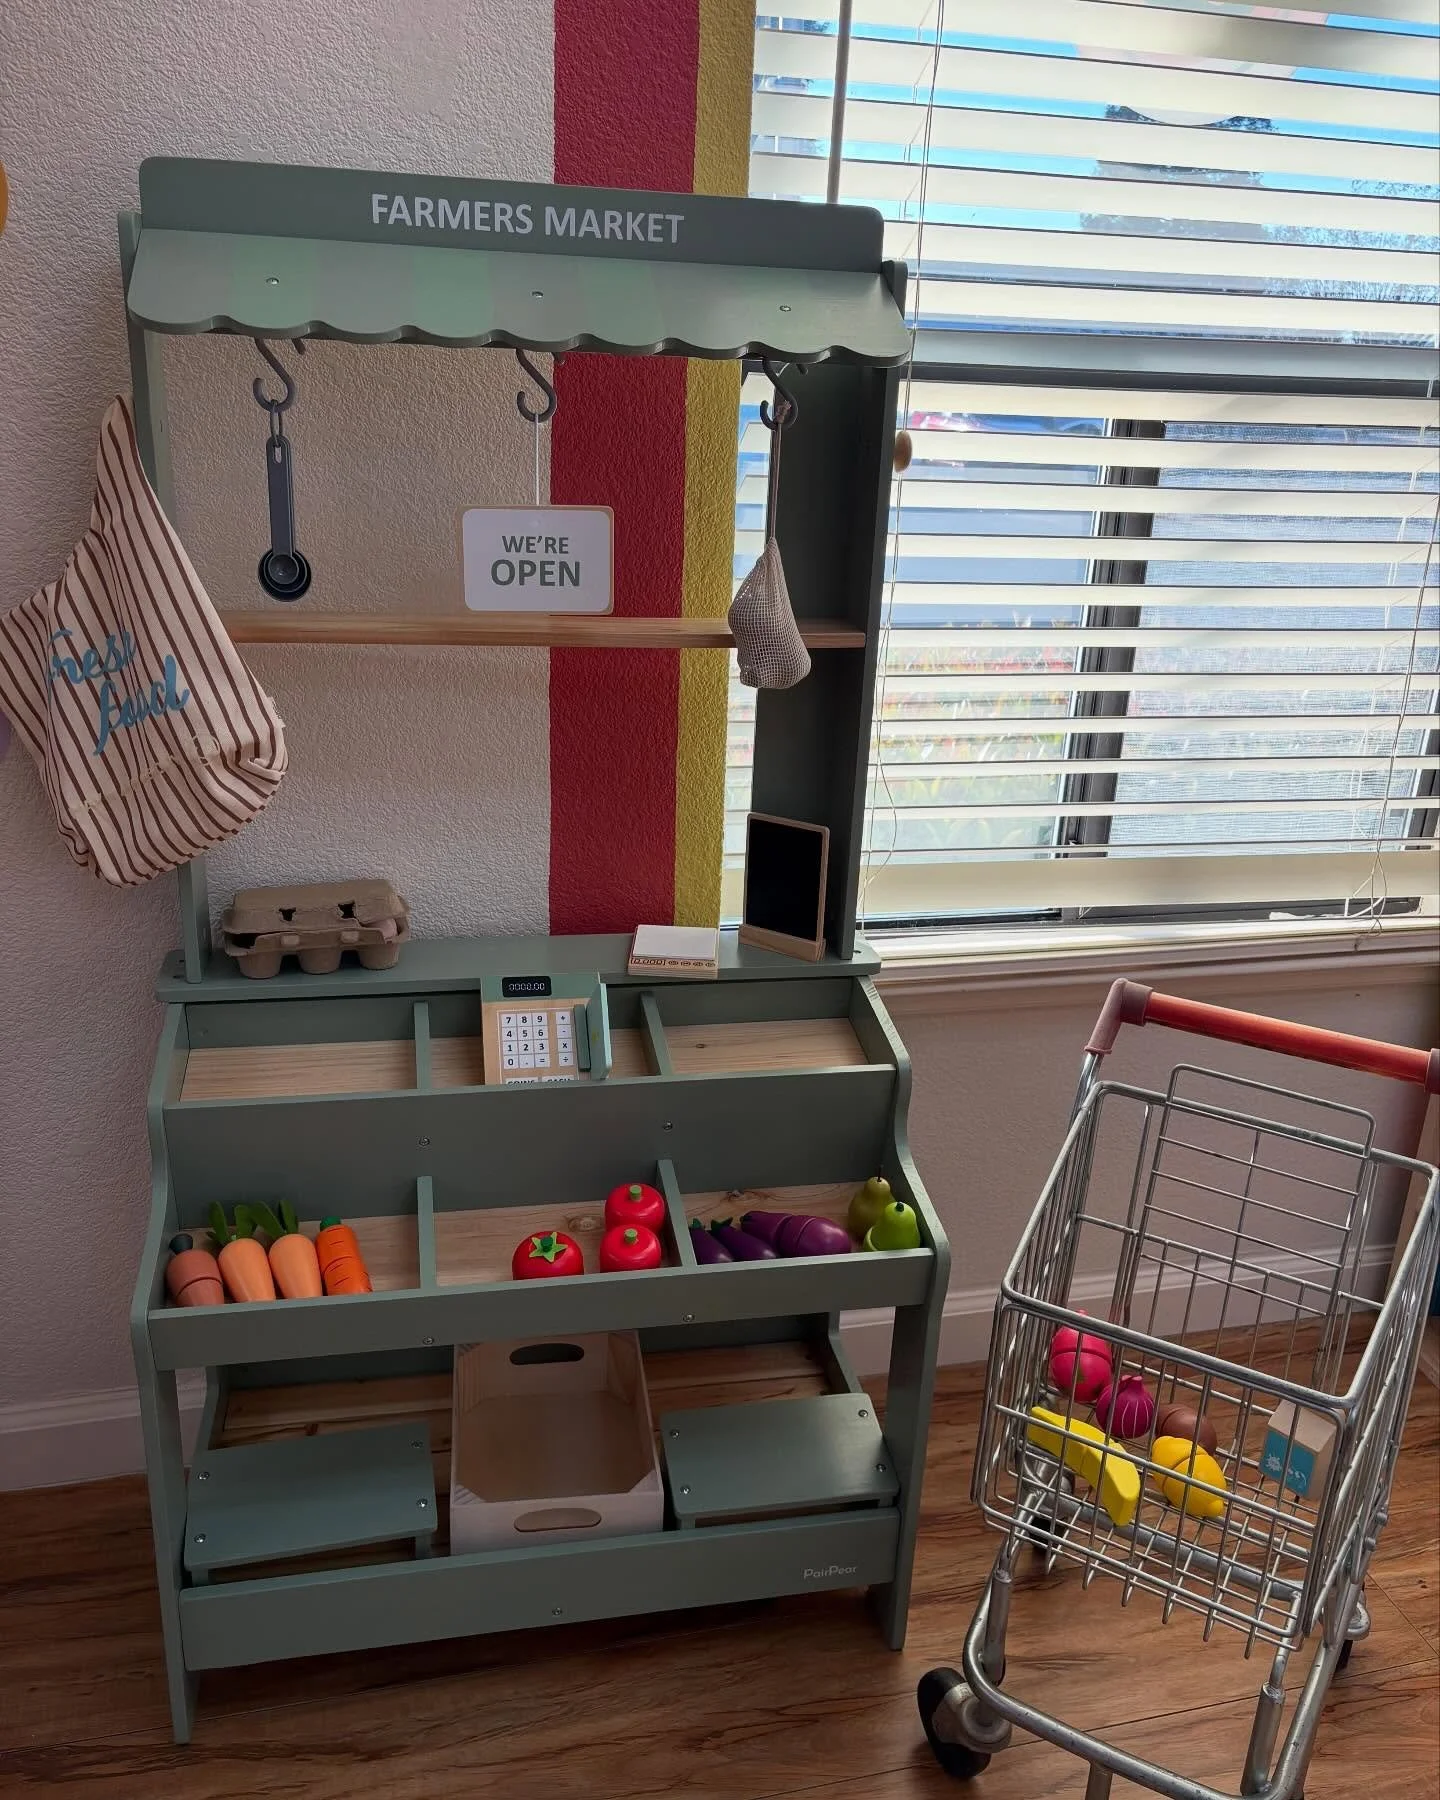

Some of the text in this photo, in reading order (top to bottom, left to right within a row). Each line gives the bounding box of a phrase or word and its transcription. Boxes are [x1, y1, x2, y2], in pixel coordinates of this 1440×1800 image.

[371, 193, 685, 243] FARMERS MARKET
[502, 535, 569, 554] WE’RE
[491, 559, 580, 587] OPEN
[537, 1015, 543, 1023] 9
[522, 1029, 528, 1037] 5
[539, 1043, 545, 1051] 3
[508, 1058, 514, 1066] 0
